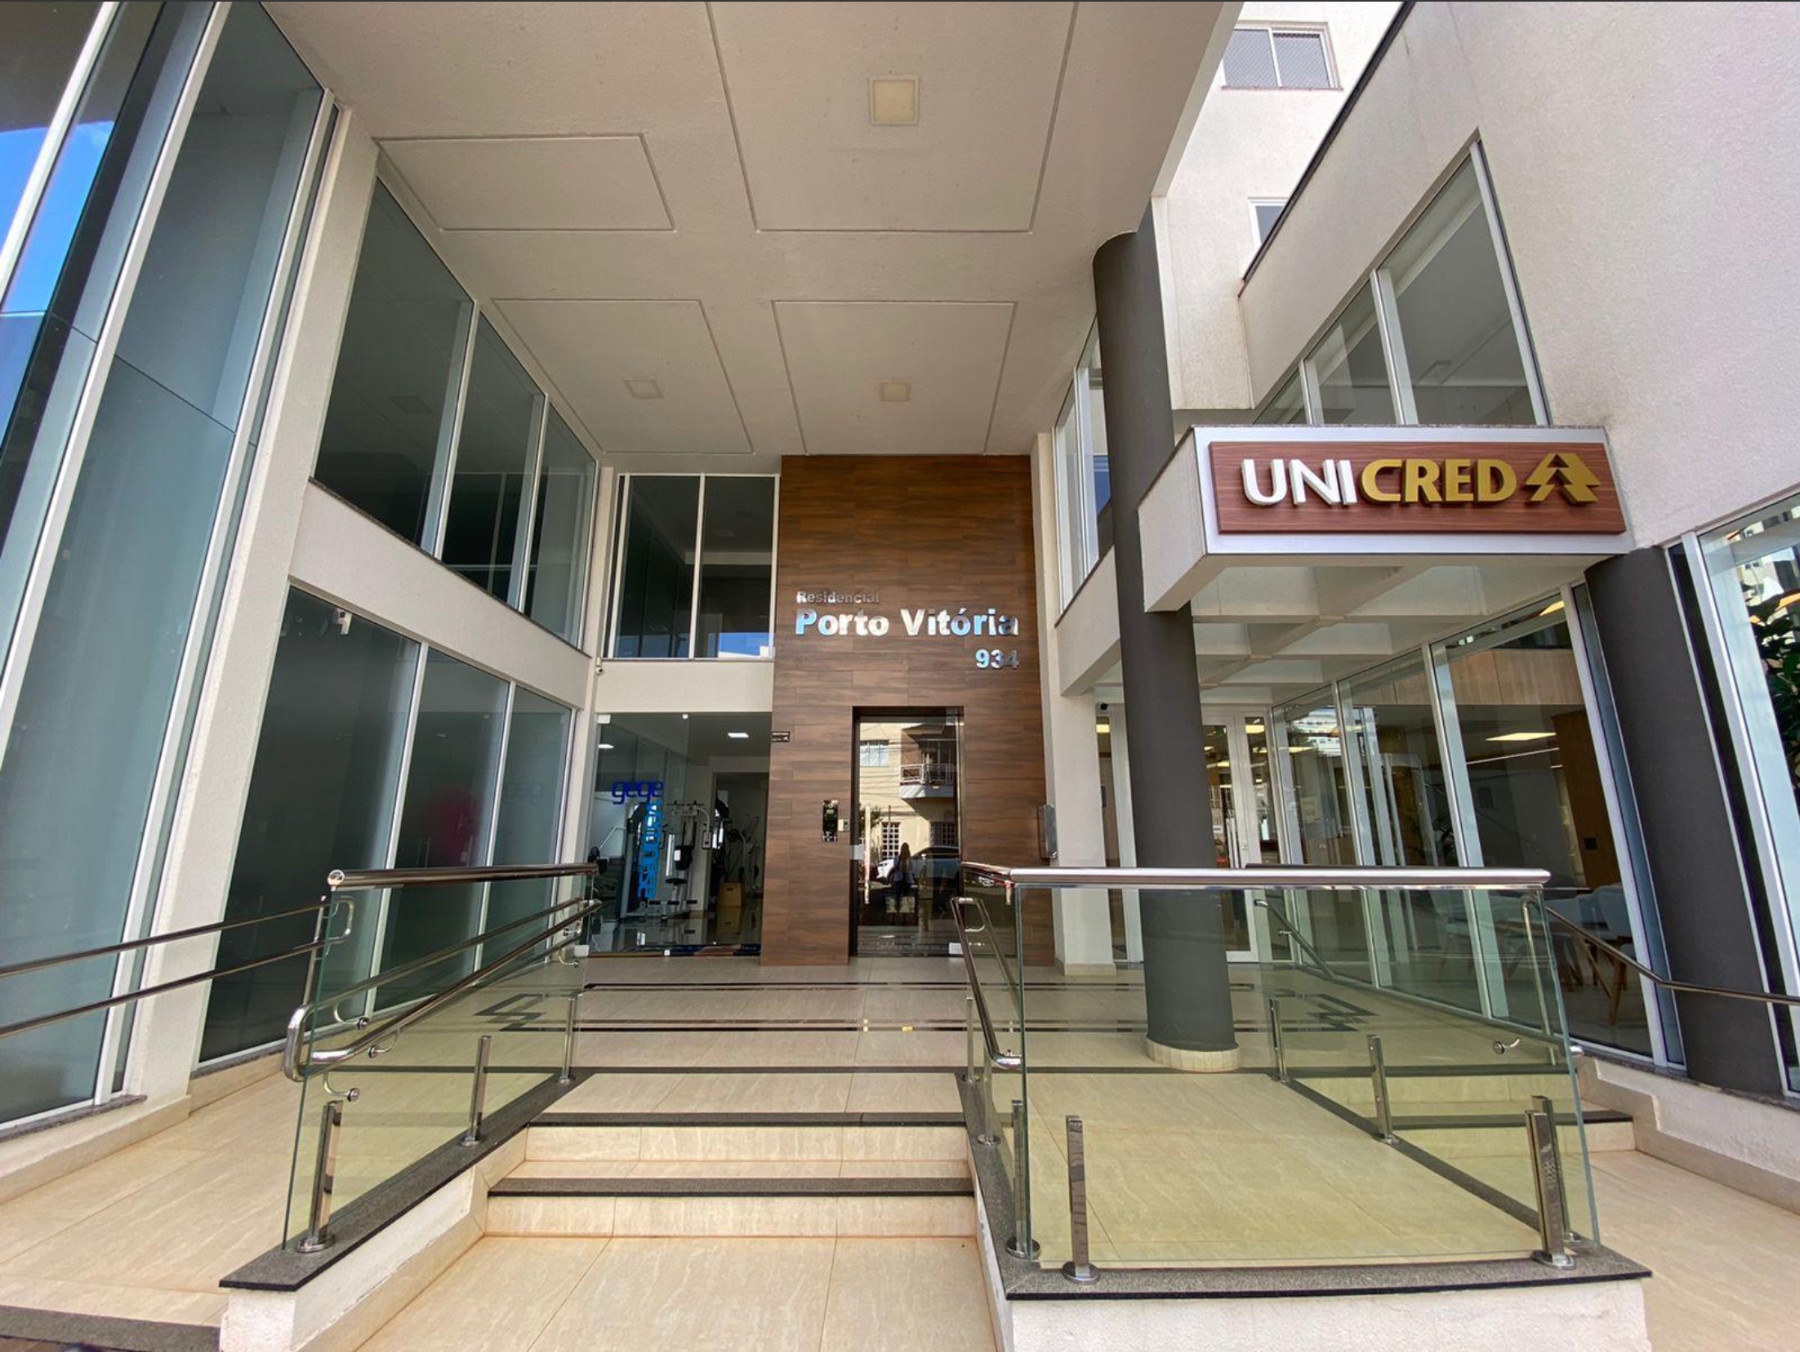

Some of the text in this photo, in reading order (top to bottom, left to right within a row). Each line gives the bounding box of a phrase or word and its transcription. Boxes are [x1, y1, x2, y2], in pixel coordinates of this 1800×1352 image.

[1240, 457, 1518, 506] UNICRED
[796, 590, 880, 604] Residencial
[795, 607, 1019, 636] Porto Vitória
[975, 649, 1019, 669] 934
